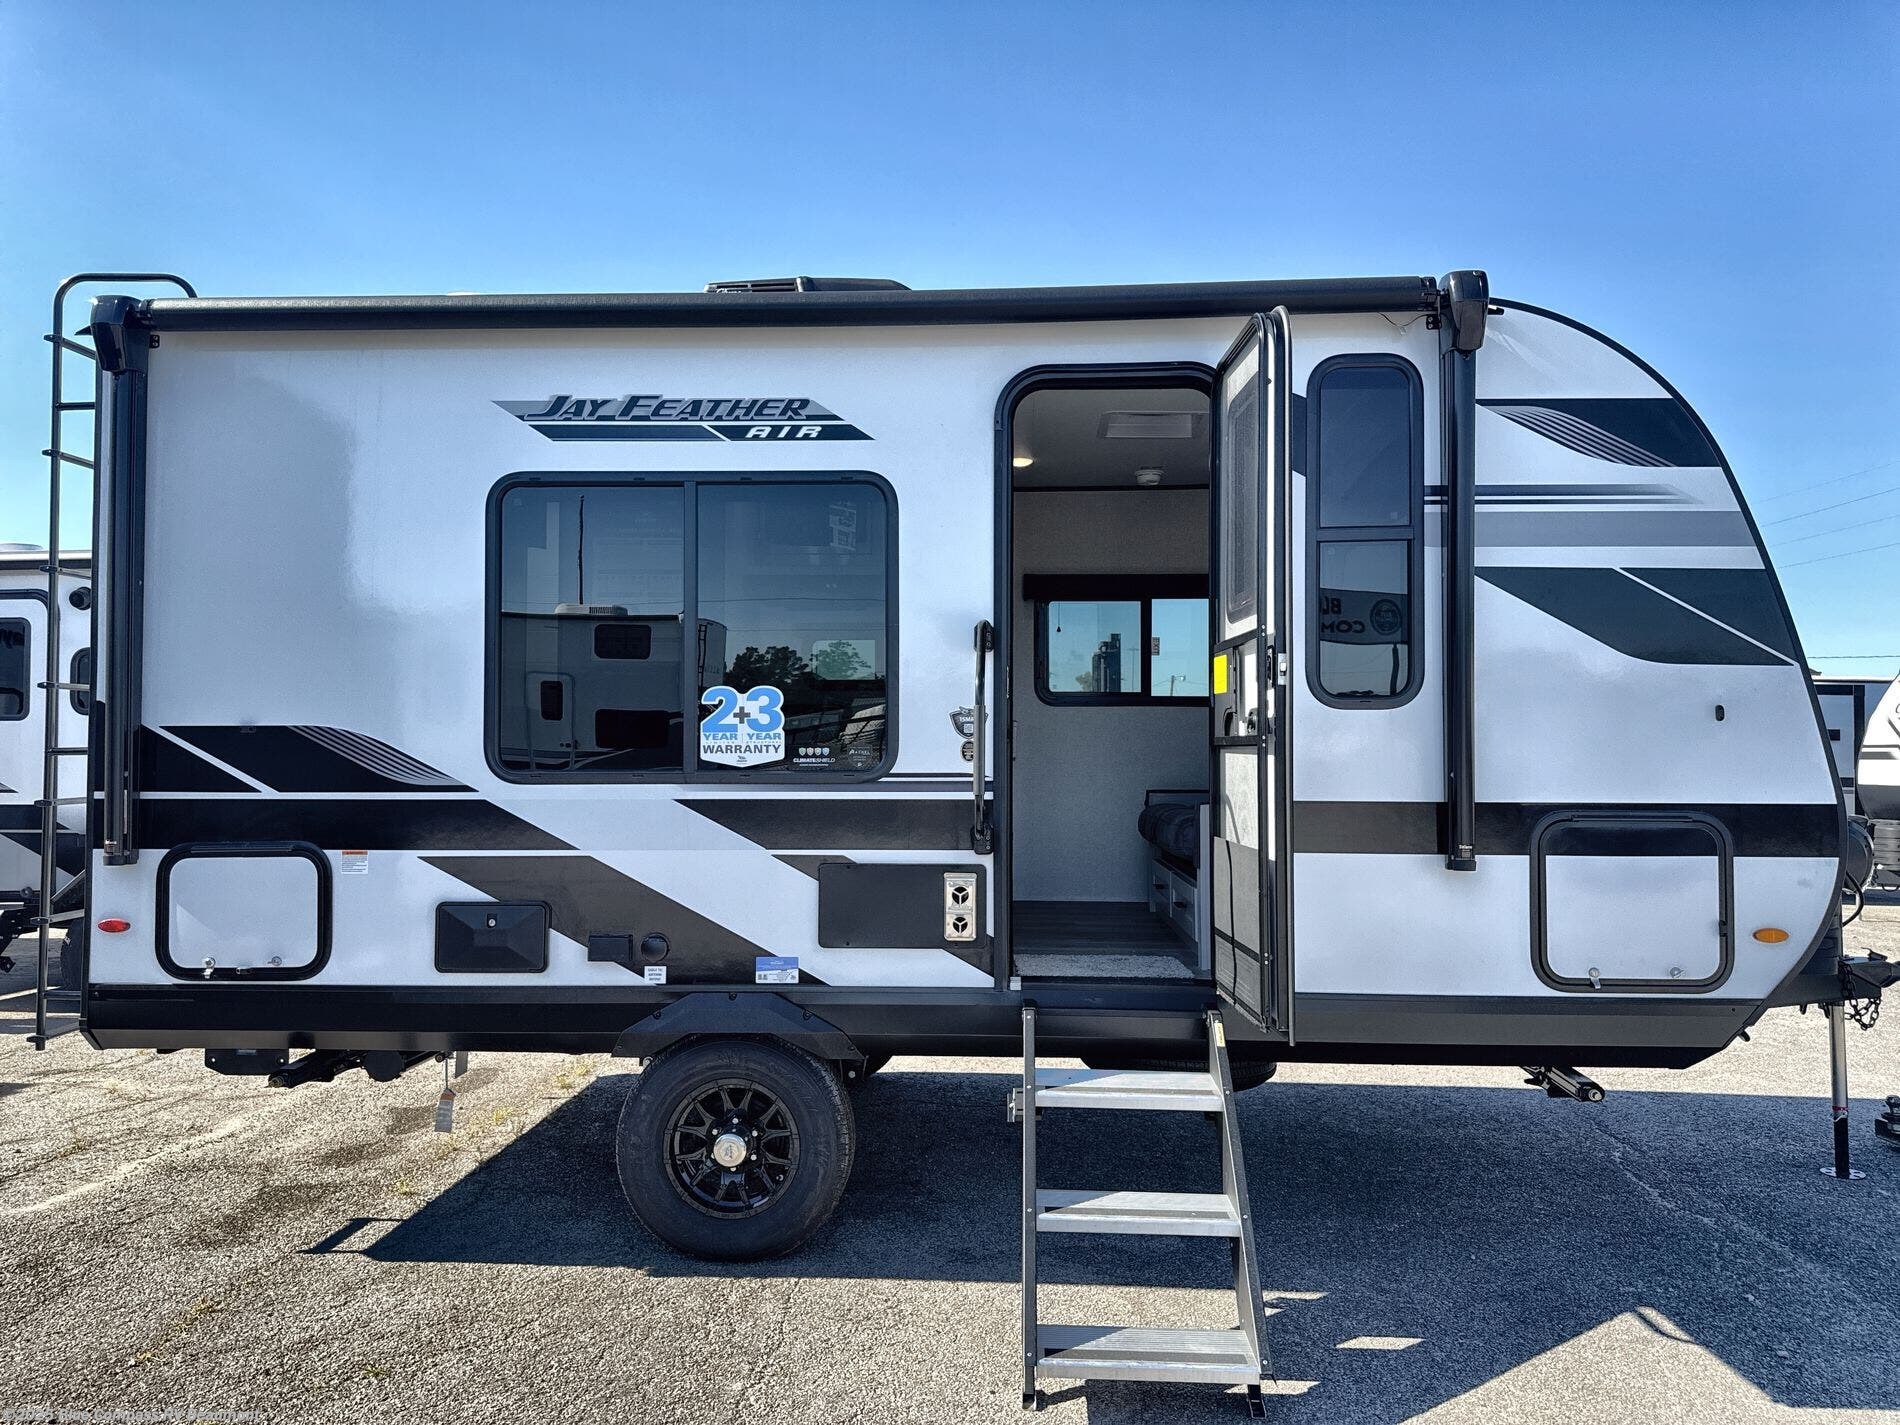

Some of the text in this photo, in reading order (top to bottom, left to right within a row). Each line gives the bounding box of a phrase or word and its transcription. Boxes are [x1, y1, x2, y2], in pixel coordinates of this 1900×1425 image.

[524, 394, 811, 421] JAY FEATHER
[745, 426, 822, 438] AIR
[703, 733, 782, 741] YEAR YEAR
[702, 744, 782, 754] WARRANTY
